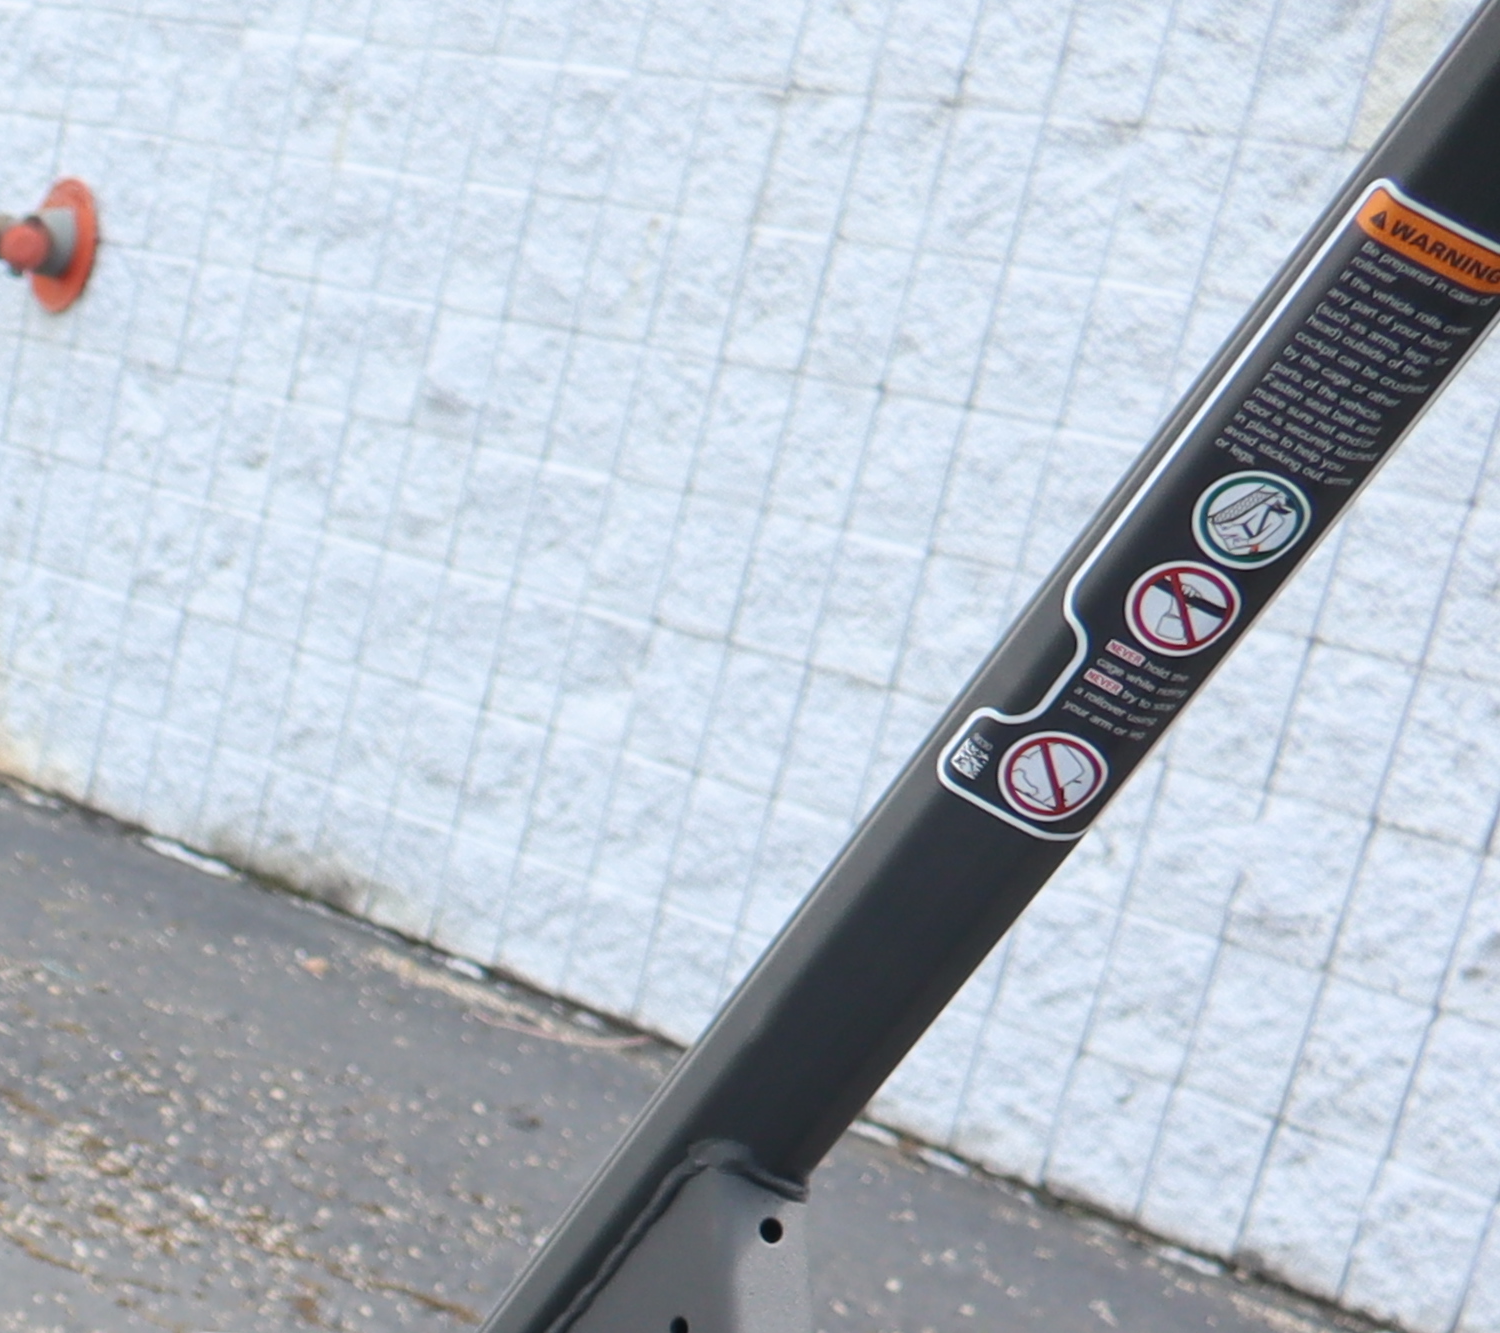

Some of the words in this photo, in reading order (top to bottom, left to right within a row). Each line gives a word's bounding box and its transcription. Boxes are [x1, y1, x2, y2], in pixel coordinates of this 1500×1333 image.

[1379, 254, 1436, 286] prepared
[1391, 220, 1500, 284] WARNING
[1327, 288, 1351, 306] any
[1350, 300, 1378, 320] part
[1390, 319, 1420, 340] your
[1373, 289, 1415, 316] vehicle
